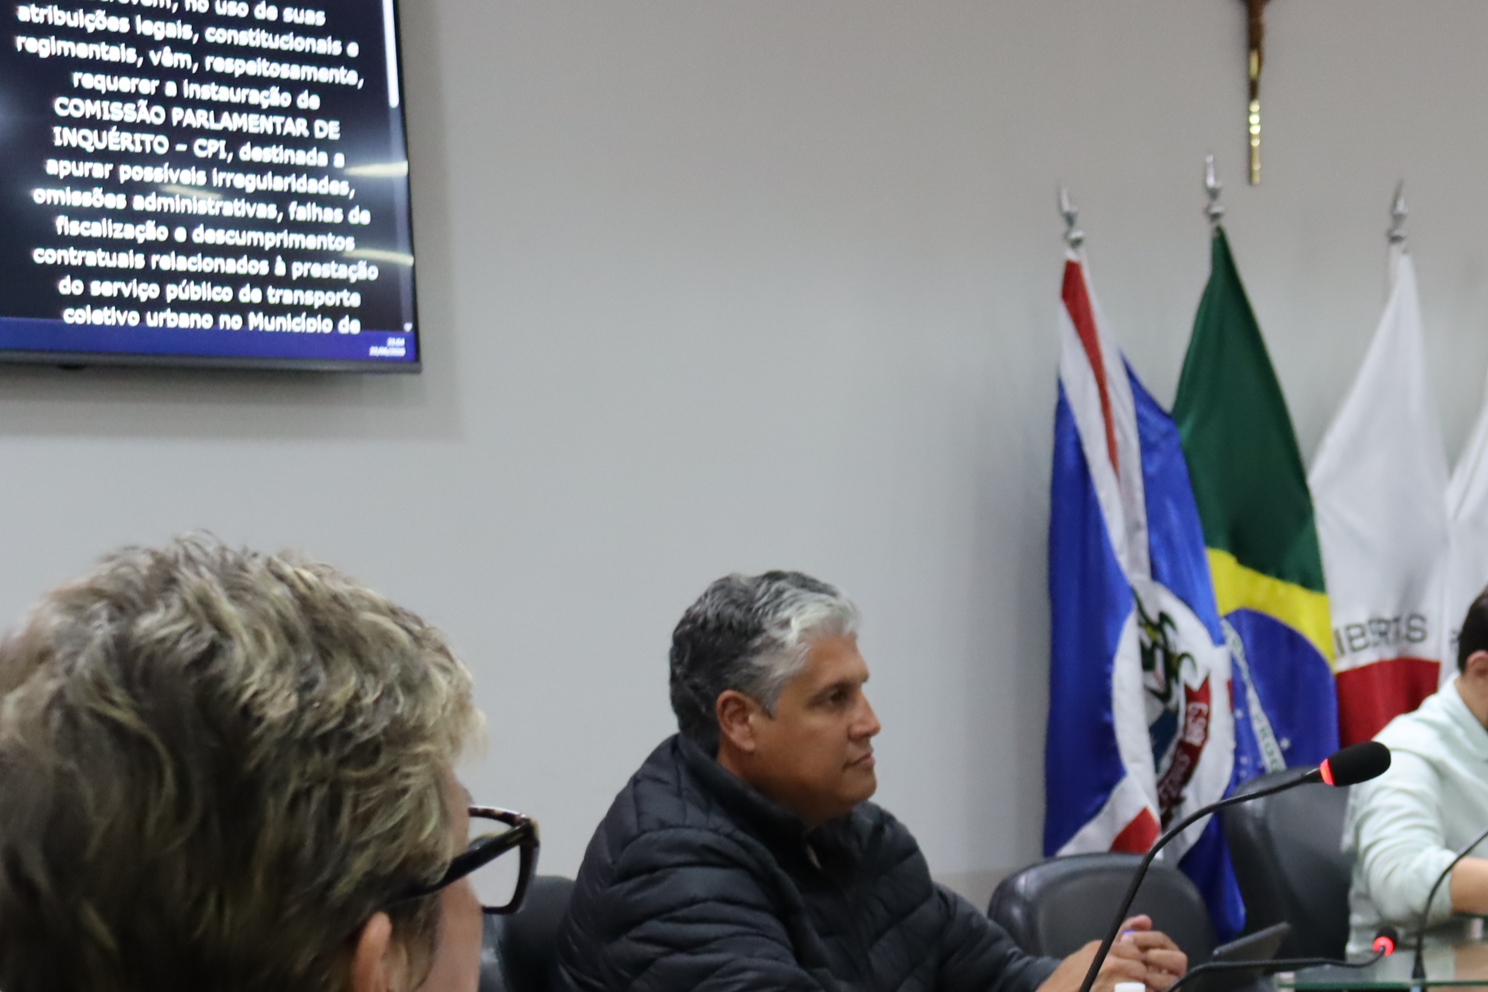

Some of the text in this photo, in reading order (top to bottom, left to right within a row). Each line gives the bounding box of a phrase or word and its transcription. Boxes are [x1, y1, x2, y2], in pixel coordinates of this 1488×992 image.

[17, 0, 131, 33] atribuições
[135, 14, 199, 45] legais,
[204, 26, 343, 56] constitucionais
[346, 41, 359, 58] e
[214, 0, 250, 18] uso
[253, 0, 279, 21] de
[282, 7, 326, 27] suas
[15, 35, 364, 90] regimentais, vêm, respeitosamente,
[72, 71, 321, 110] requerer a instauração de
[53, 96, 341, 140] COMISSÃO PARLAMENTAR DE
[52, 125, 170, 155] INQUÉRITO
[193, 138, 234, 164] CPI,
[238, 141, 329, 167] destinada
[333, 152, 346, 169] a
[45, 158, 356, 200] apurar possíveis irregularidades,
[31, 186, 371, 226] omissões administrativas, falhas de
[55, 214, 355, 255] fiscalização e descumprimentos
[32, 246, 379, 284] contratuais relacionados à prestação
[58, 274, 361, 309] do serviço público de transporte
[62, 304, 361, 335] coletivo urbano no Município de
